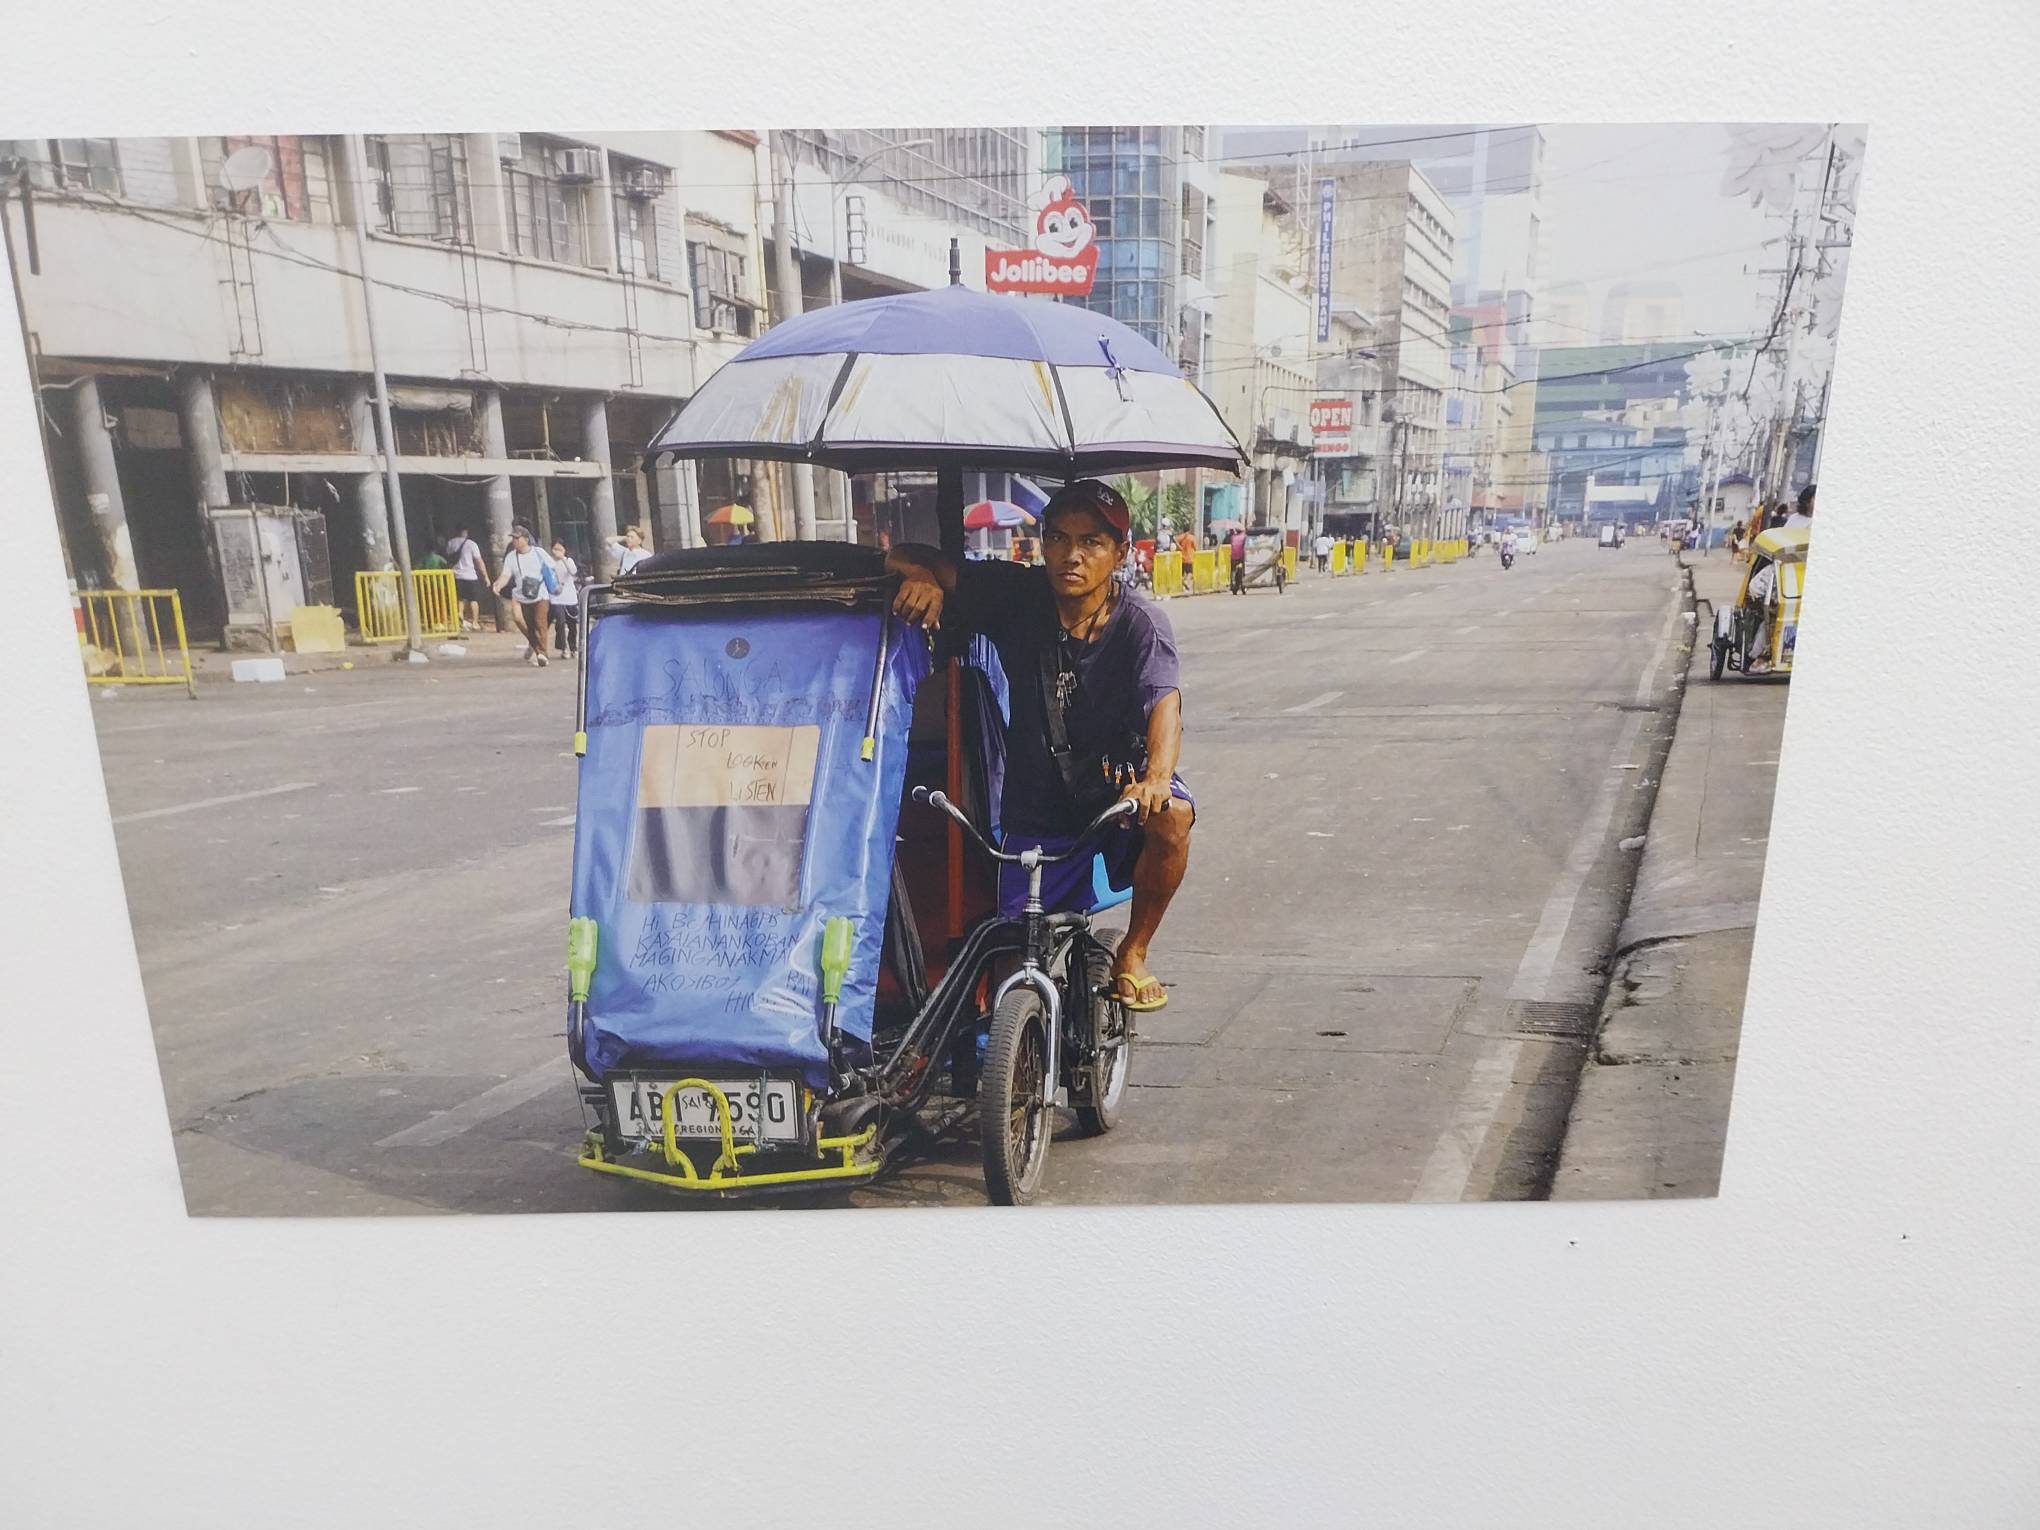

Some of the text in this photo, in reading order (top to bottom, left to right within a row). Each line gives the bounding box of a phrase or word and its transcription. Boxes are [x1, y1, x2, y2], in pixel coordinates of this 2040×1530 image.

[991, 256, 1087, 283] Jollibee
[1318, 296, 1329, 337] BANK
[1311, 407, 1352, 427] OPEN
[687, 728, 731, 748] STOP
